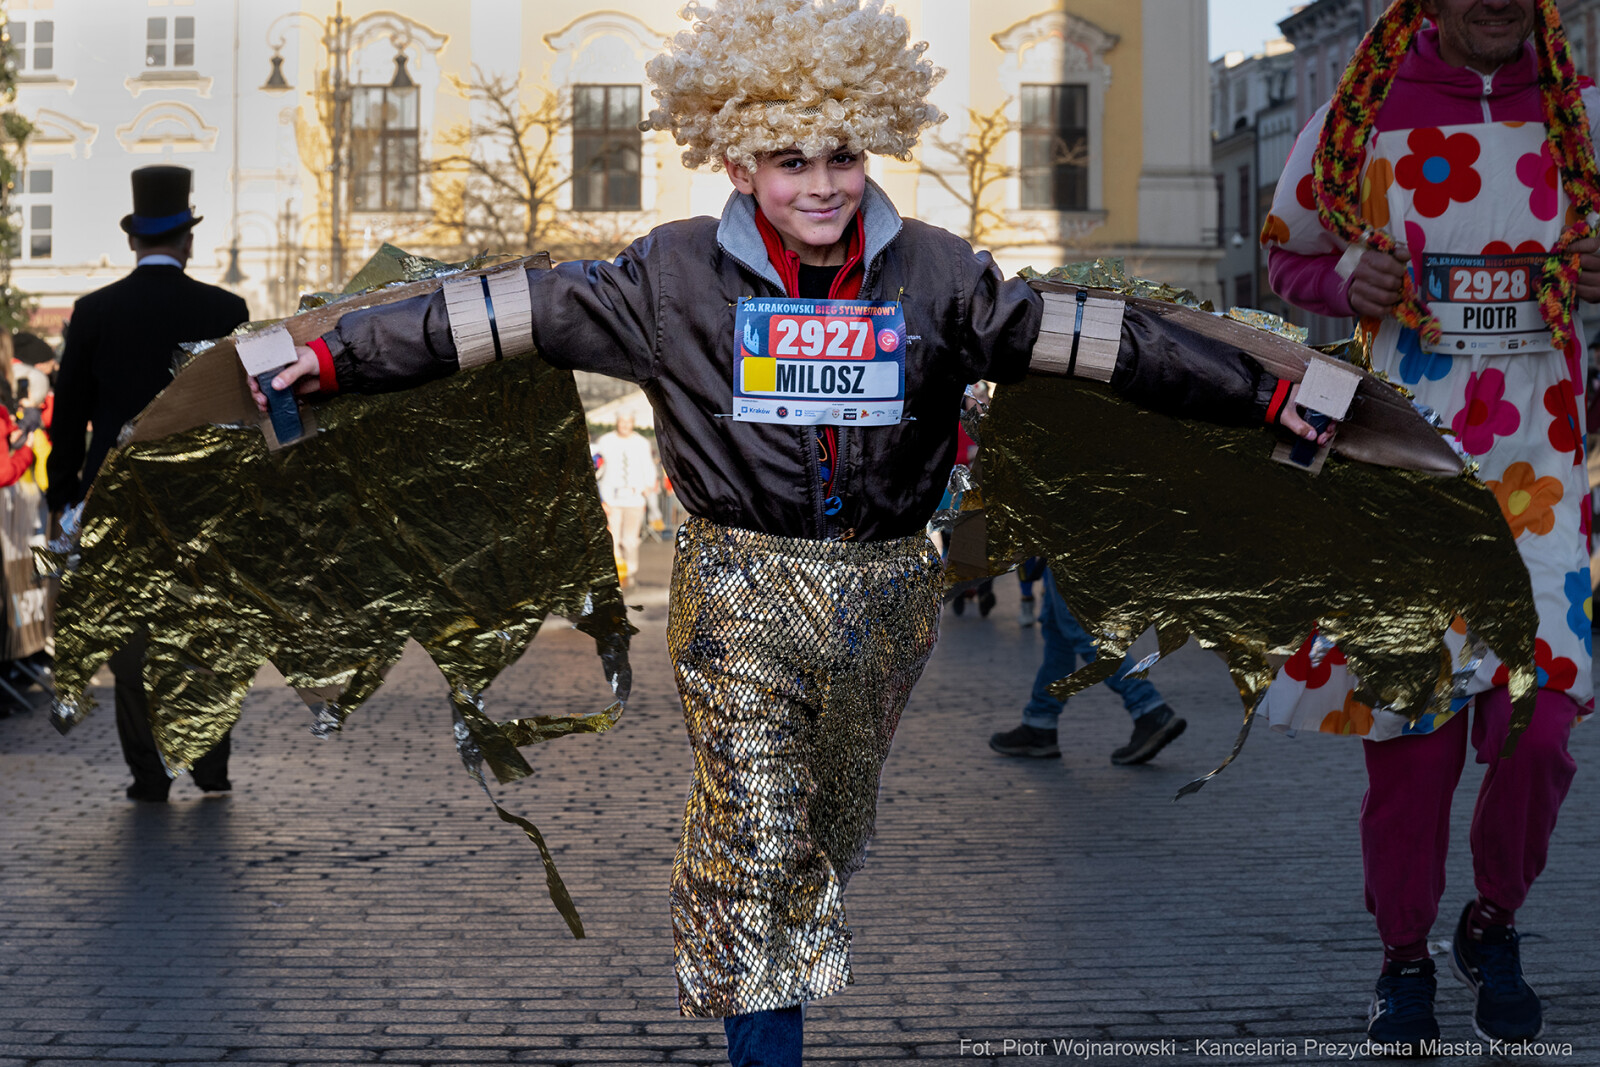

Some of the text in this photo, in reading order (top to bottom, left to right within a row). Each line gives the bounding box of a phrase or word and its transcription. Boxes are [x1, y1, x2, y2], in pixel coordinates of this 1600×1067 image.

[1439, 257, 1485, 267] KRAKOWSKI
[1453, 269, 1527, 300] 2928
[743, 303, 896, 316] 20. KRAKOWSKI BIEG SYLWESTROWY
[1463, 306, 1517, 330] PIOTR
[776, 319, 869, 357] 2927
[776, 364, 866, 395] MILOSZ
